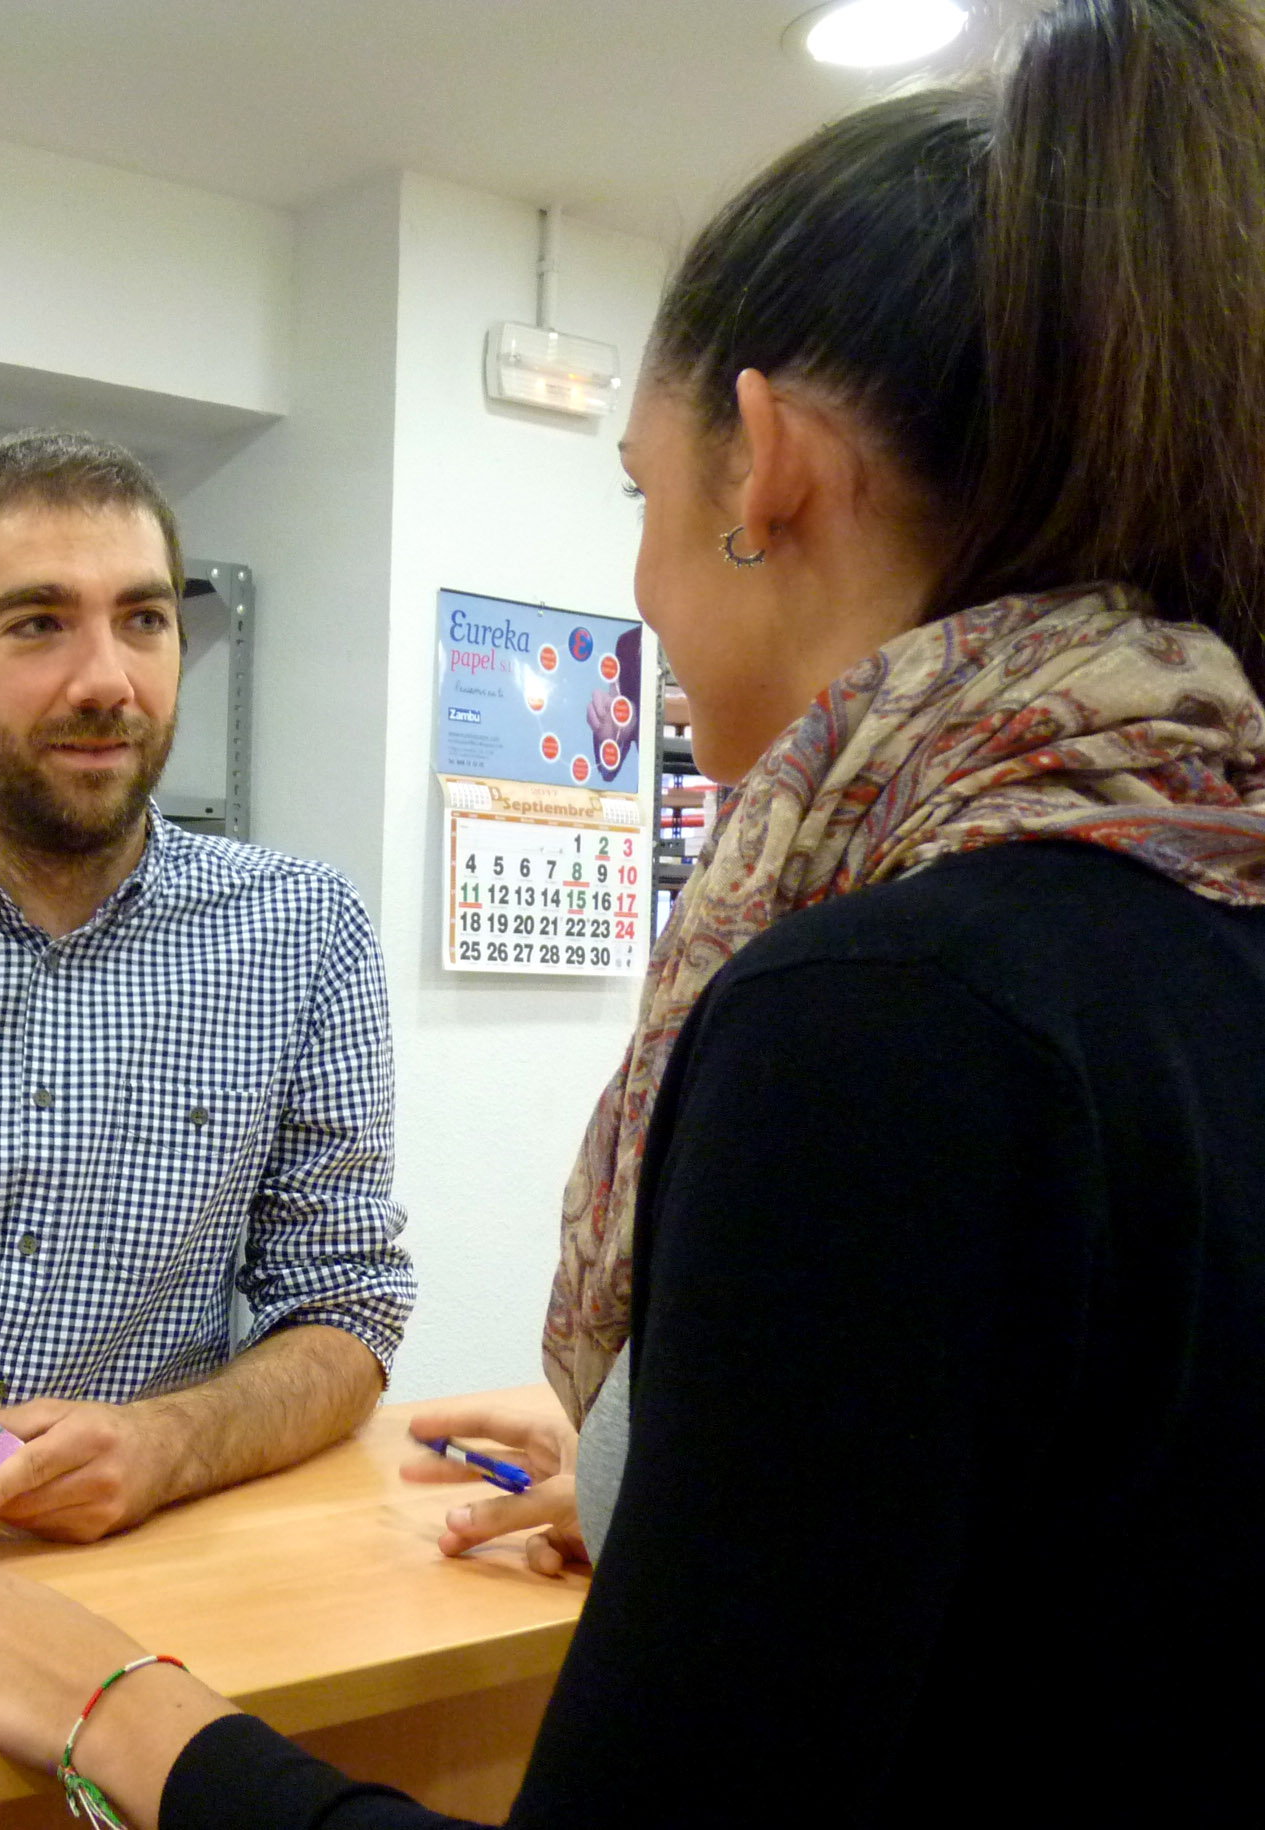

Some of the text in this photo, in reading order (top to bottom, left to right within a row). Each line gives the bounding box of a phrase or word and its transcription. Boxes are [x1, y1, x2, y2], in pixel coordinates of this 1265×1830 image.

[450, 609, 530, 653] Eureka
[451, 648, 496, 675] papel
[449, 708, 481, 722] Zambu
[502, 797, 595, 818] Septiembre
[574, 834, 633, 857] 1 2 3
[465, 854, 638, 885] 4 5 6 7 8 9 10
[460, 882, 636, 912] 11 12 13 14 15 16 17
[460, 912, 635, 940] 18 19 20 21 22 23 24
[460, 940, 610, 966] 25 26 27 28 29 30
